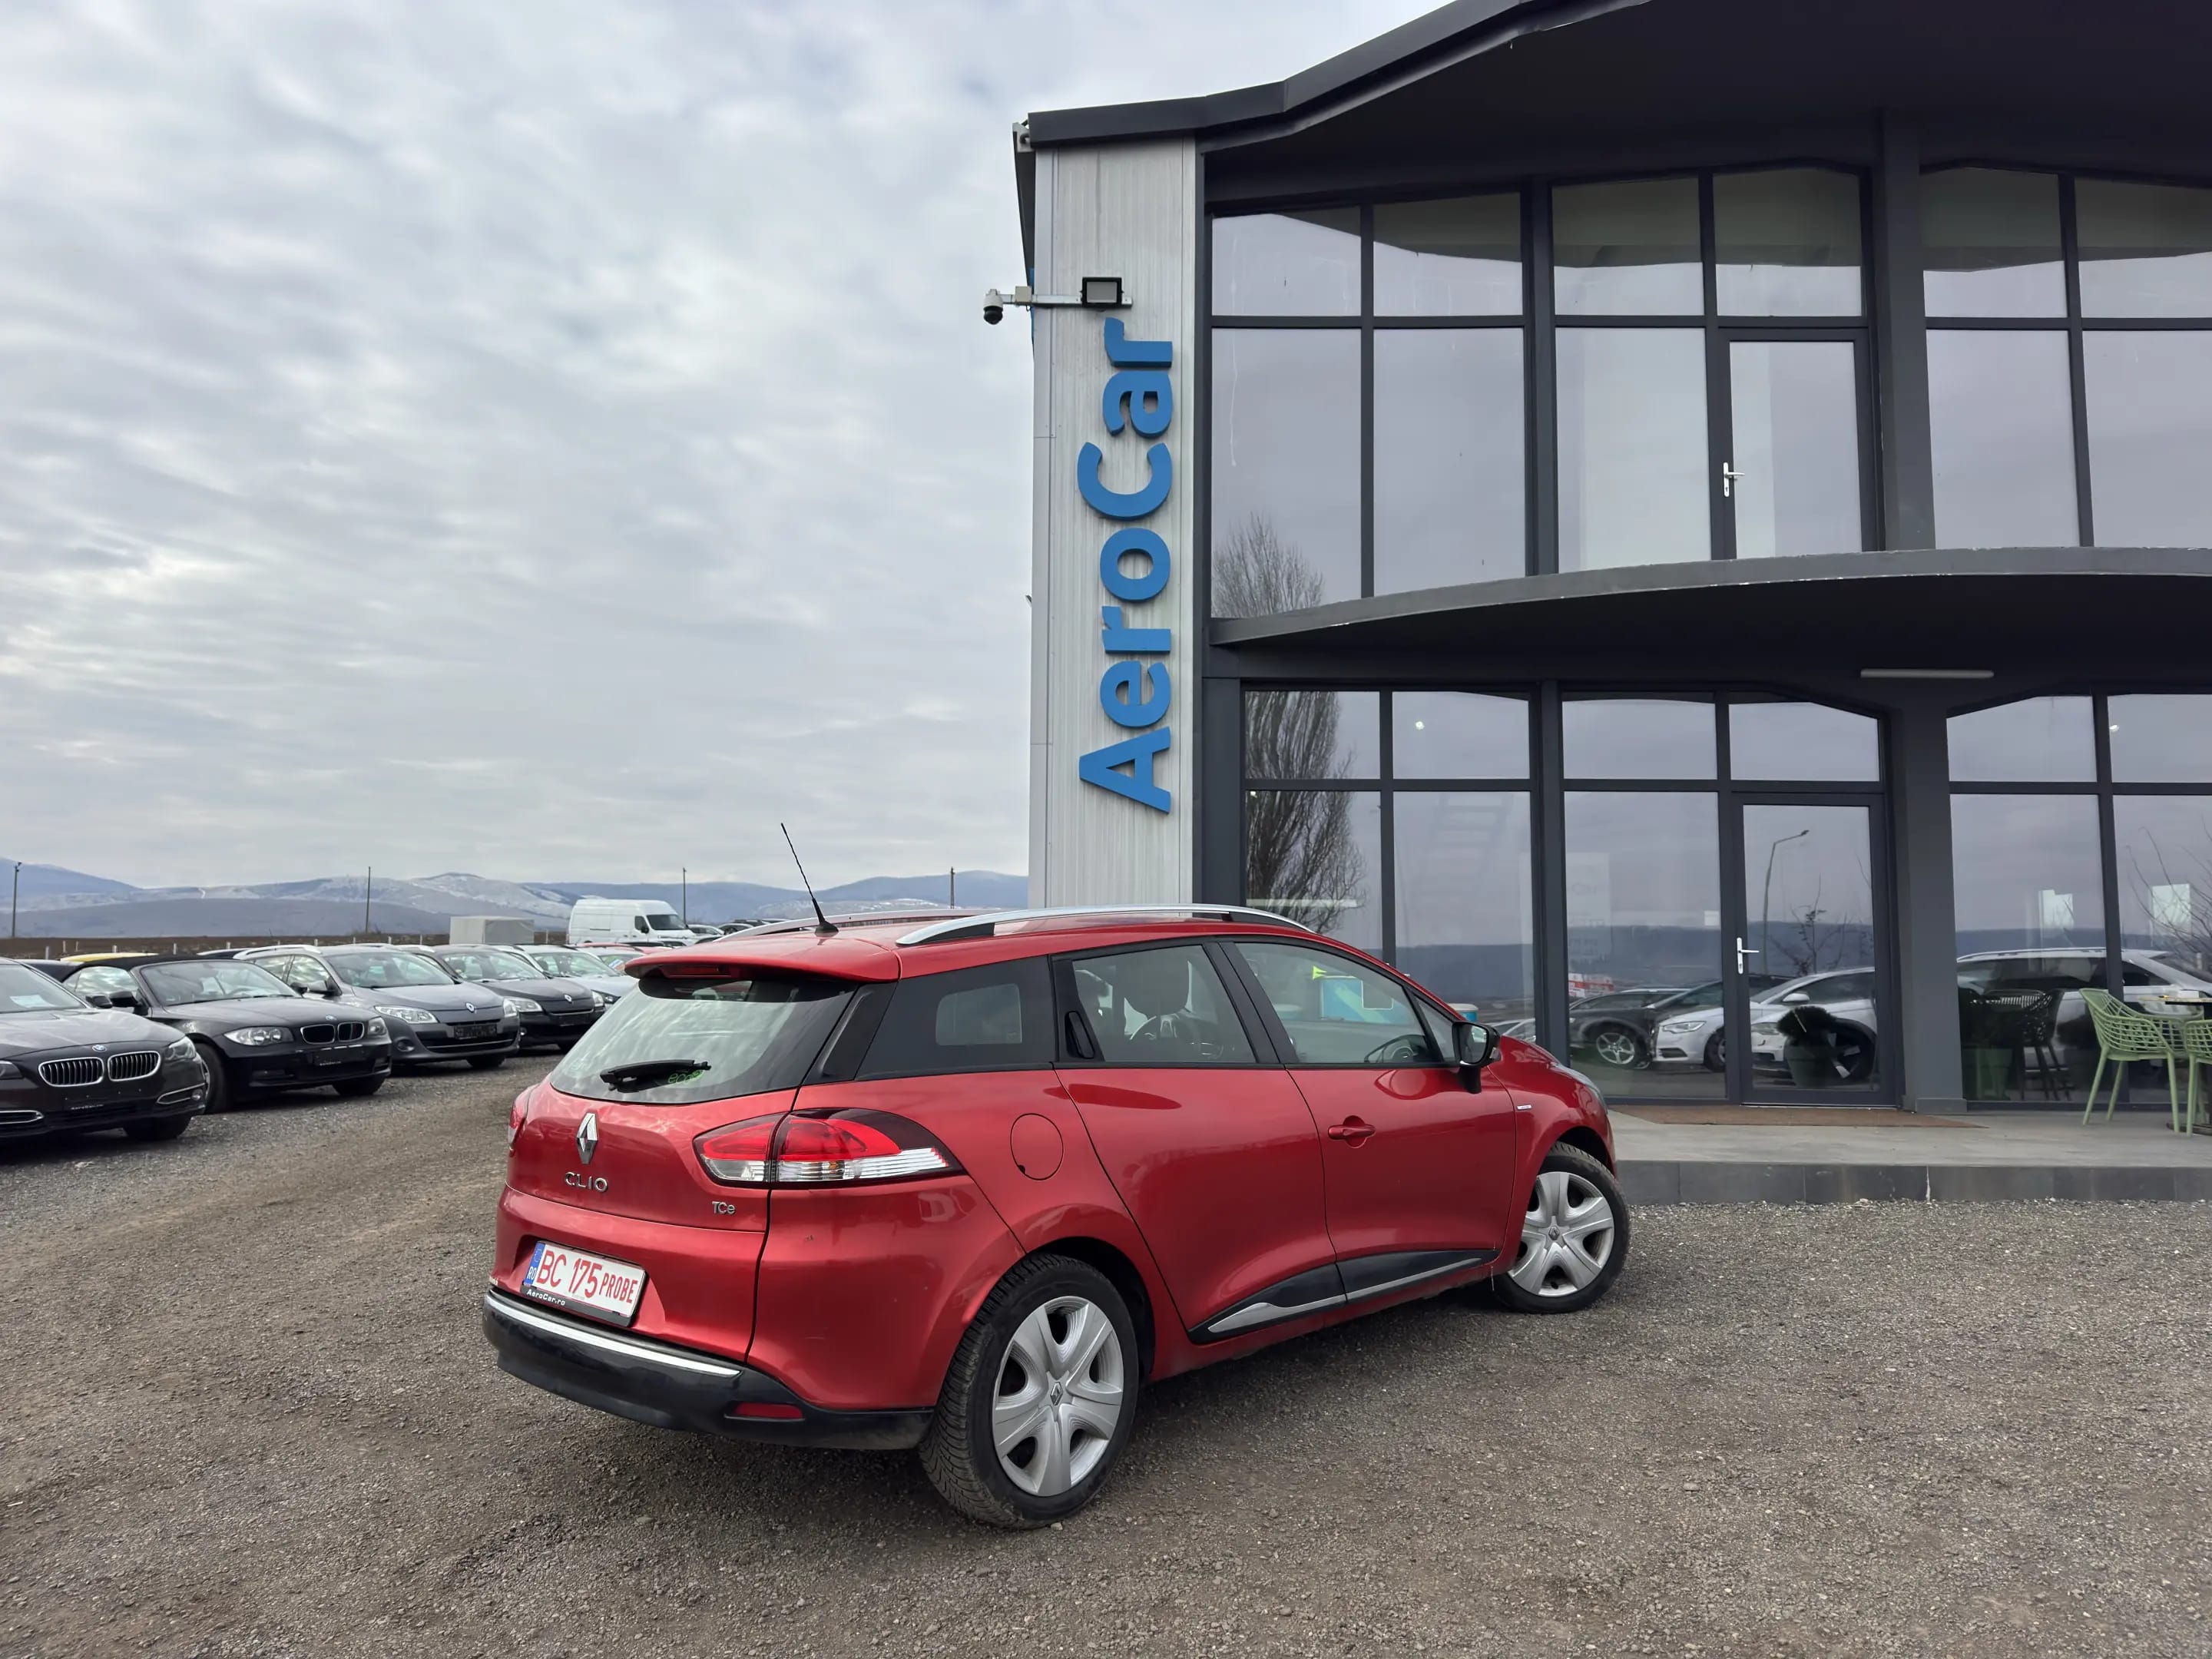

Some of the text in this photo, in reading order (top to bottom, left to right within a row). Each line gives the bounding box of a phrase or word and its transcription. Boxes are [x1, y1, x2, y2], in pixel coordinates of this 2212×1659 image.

[1077, 317, 1173, 814] AeroCar
[565, 1171, 608, 1192] CLIO
[711, 1200, 736, 1215] TCe
[527, 1266, 537, 1280] RO
[536, 1250, 638, 1303] BC 175 PROBE
[527, 1289, 566, 1306] AeroCar.ro
